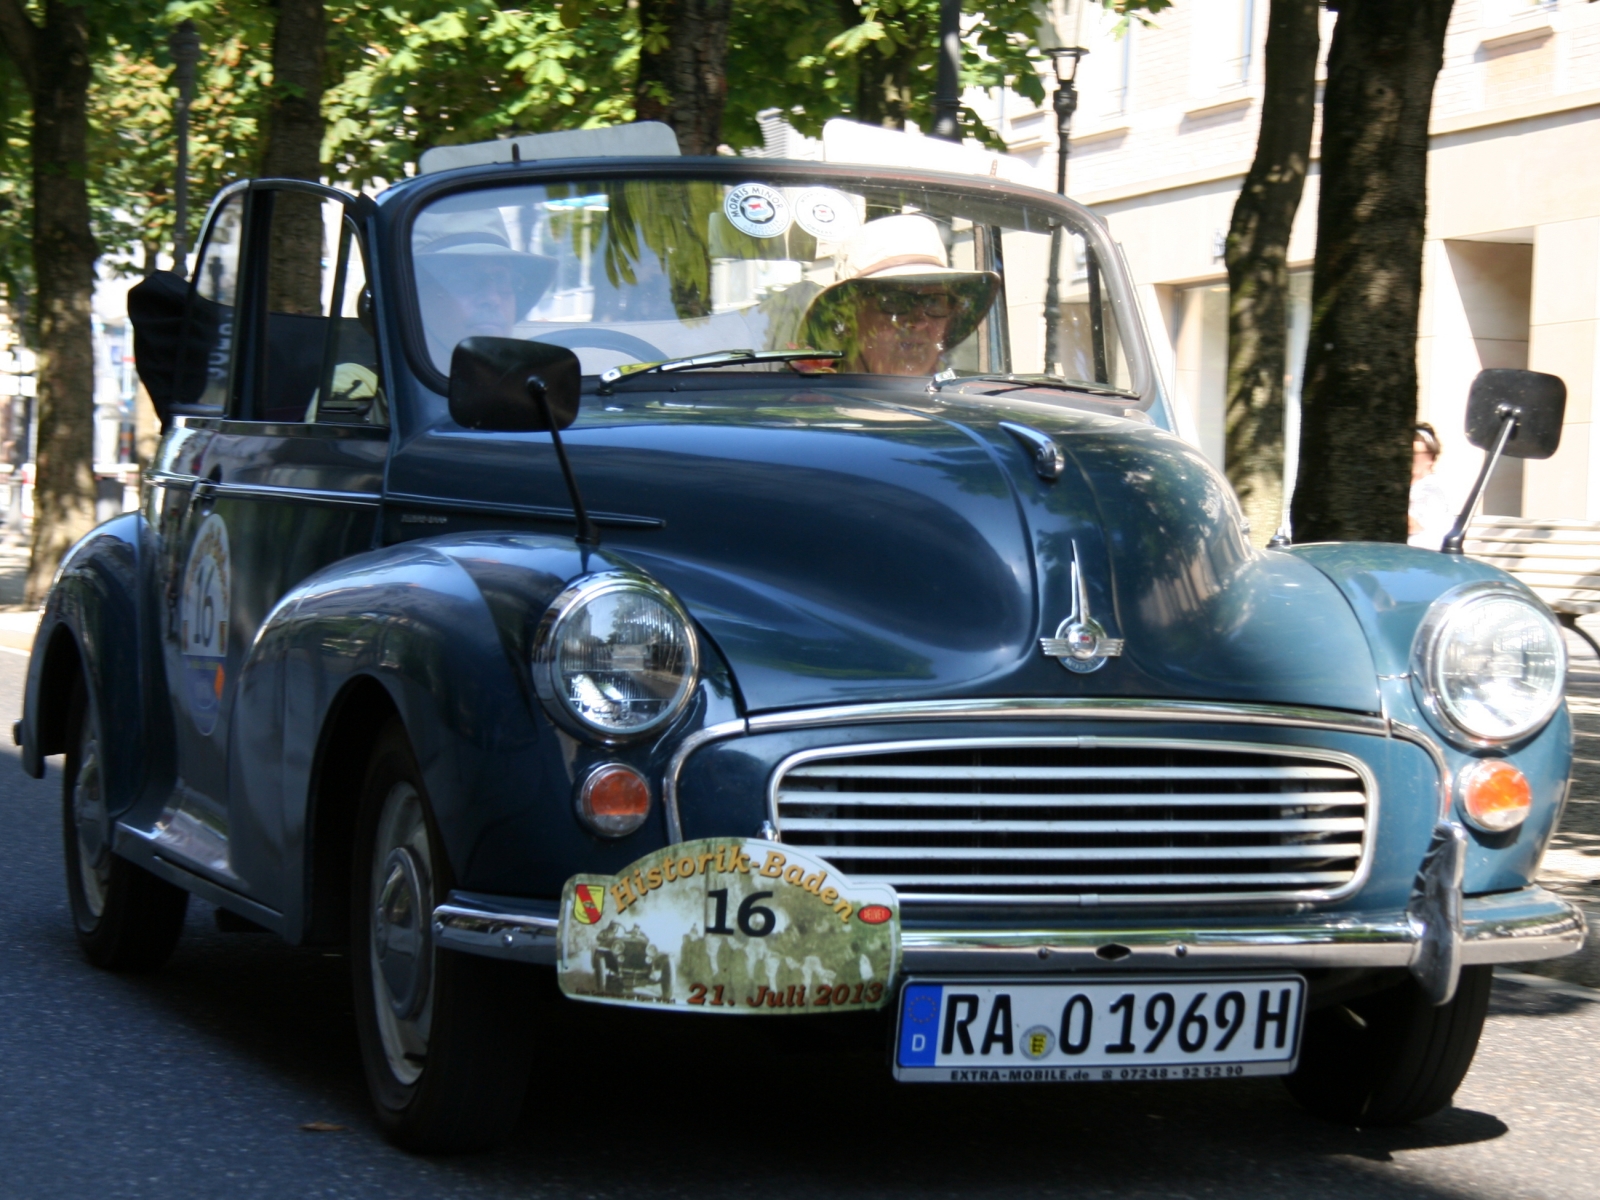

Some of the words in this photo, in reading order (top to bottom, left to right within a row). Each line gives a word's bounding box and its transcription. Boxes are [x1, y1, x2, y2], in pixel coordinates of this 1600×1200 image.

[729, 188, 749, 218] MORRIS
[752, 187, 783, 209] MINOR
[610, 845, 854, 924] Historik-Baden
[705, 888, 776, 938] 16
[687, 983, 735, 1006] 21.
[747, 983, 805, 1007] Juli
[812, 982, 884, 1005] 2013
[941, 993, 1014, 1055] RA
[911, 1034, 926, 1052] D
[950, 1068, 1090, 1081] EXTRA-MOBILE.de
[1120, 1067, 1168, 1079] 07248
